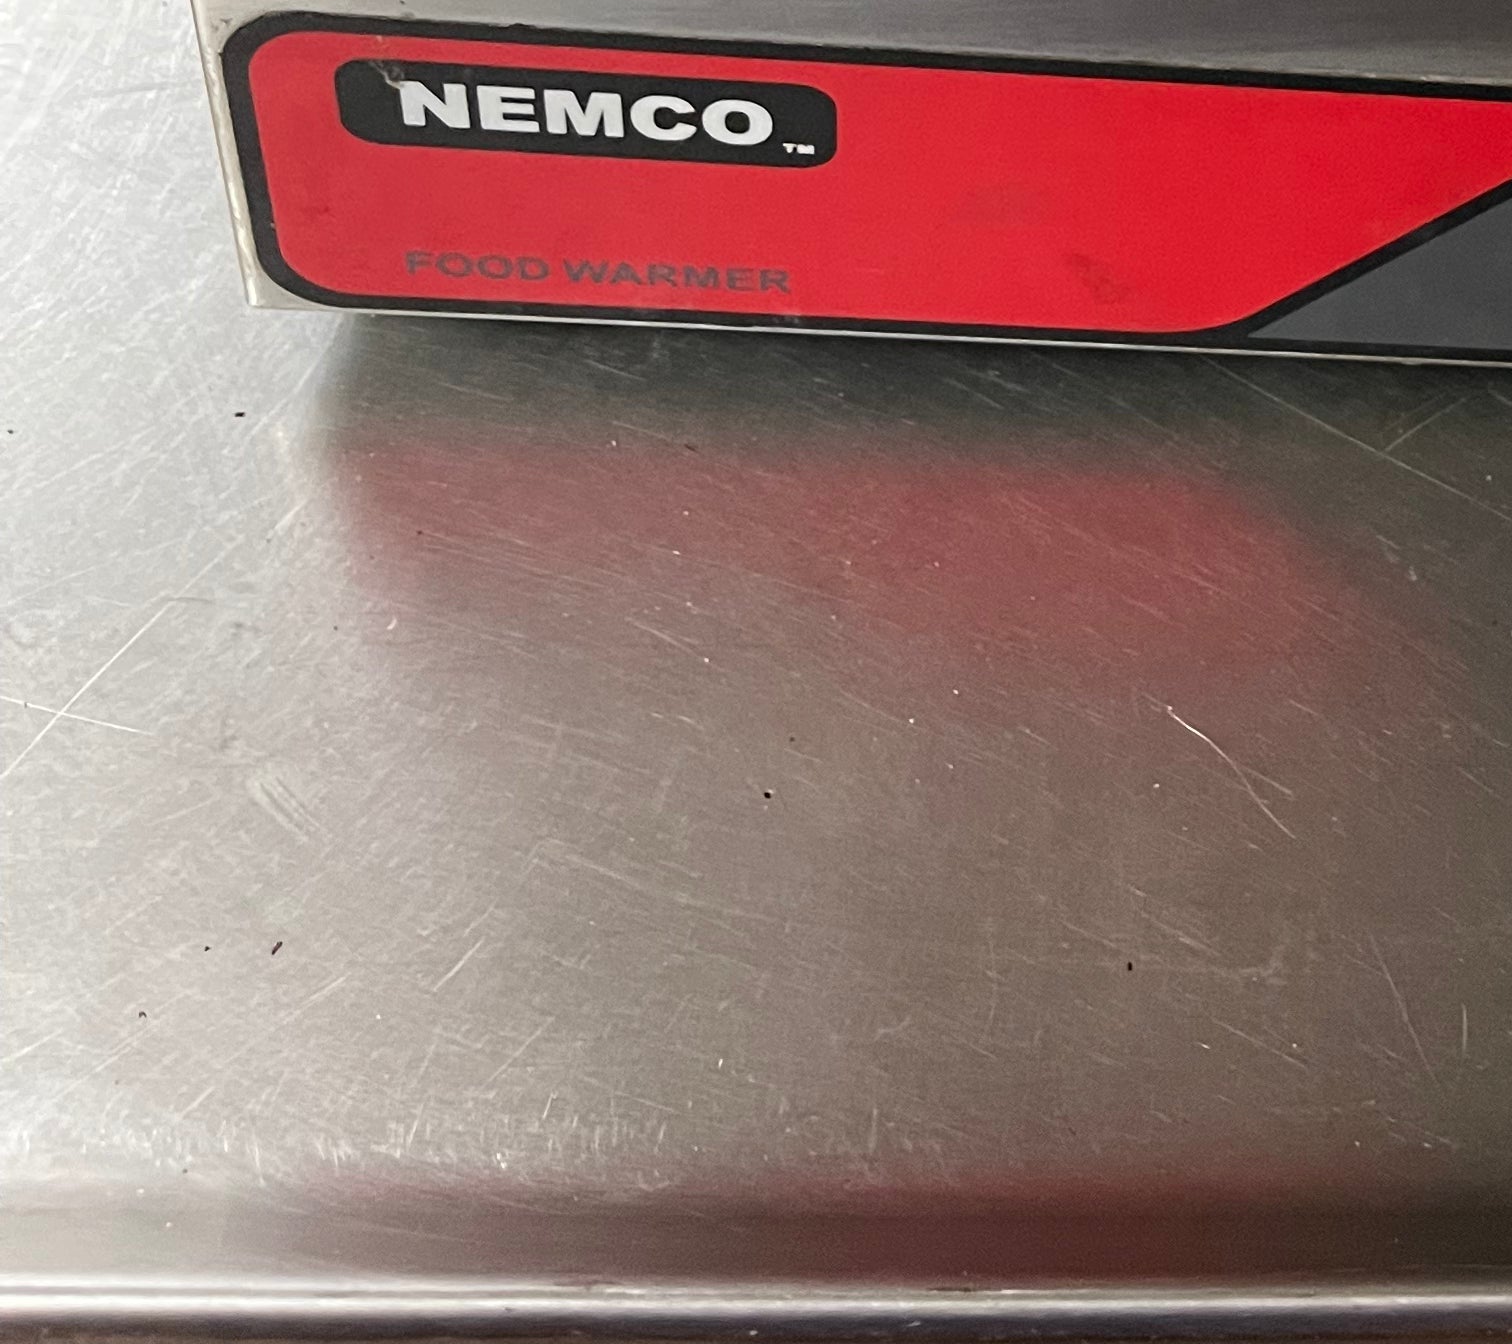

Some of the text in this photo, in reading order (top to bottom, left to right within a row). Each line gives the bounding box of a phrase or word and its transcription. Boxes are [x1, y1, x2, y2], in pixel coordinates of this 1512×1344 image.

[401, 81, 773, 145] NEMCO
[405, 251, 790, 292] FOOD WARMER
